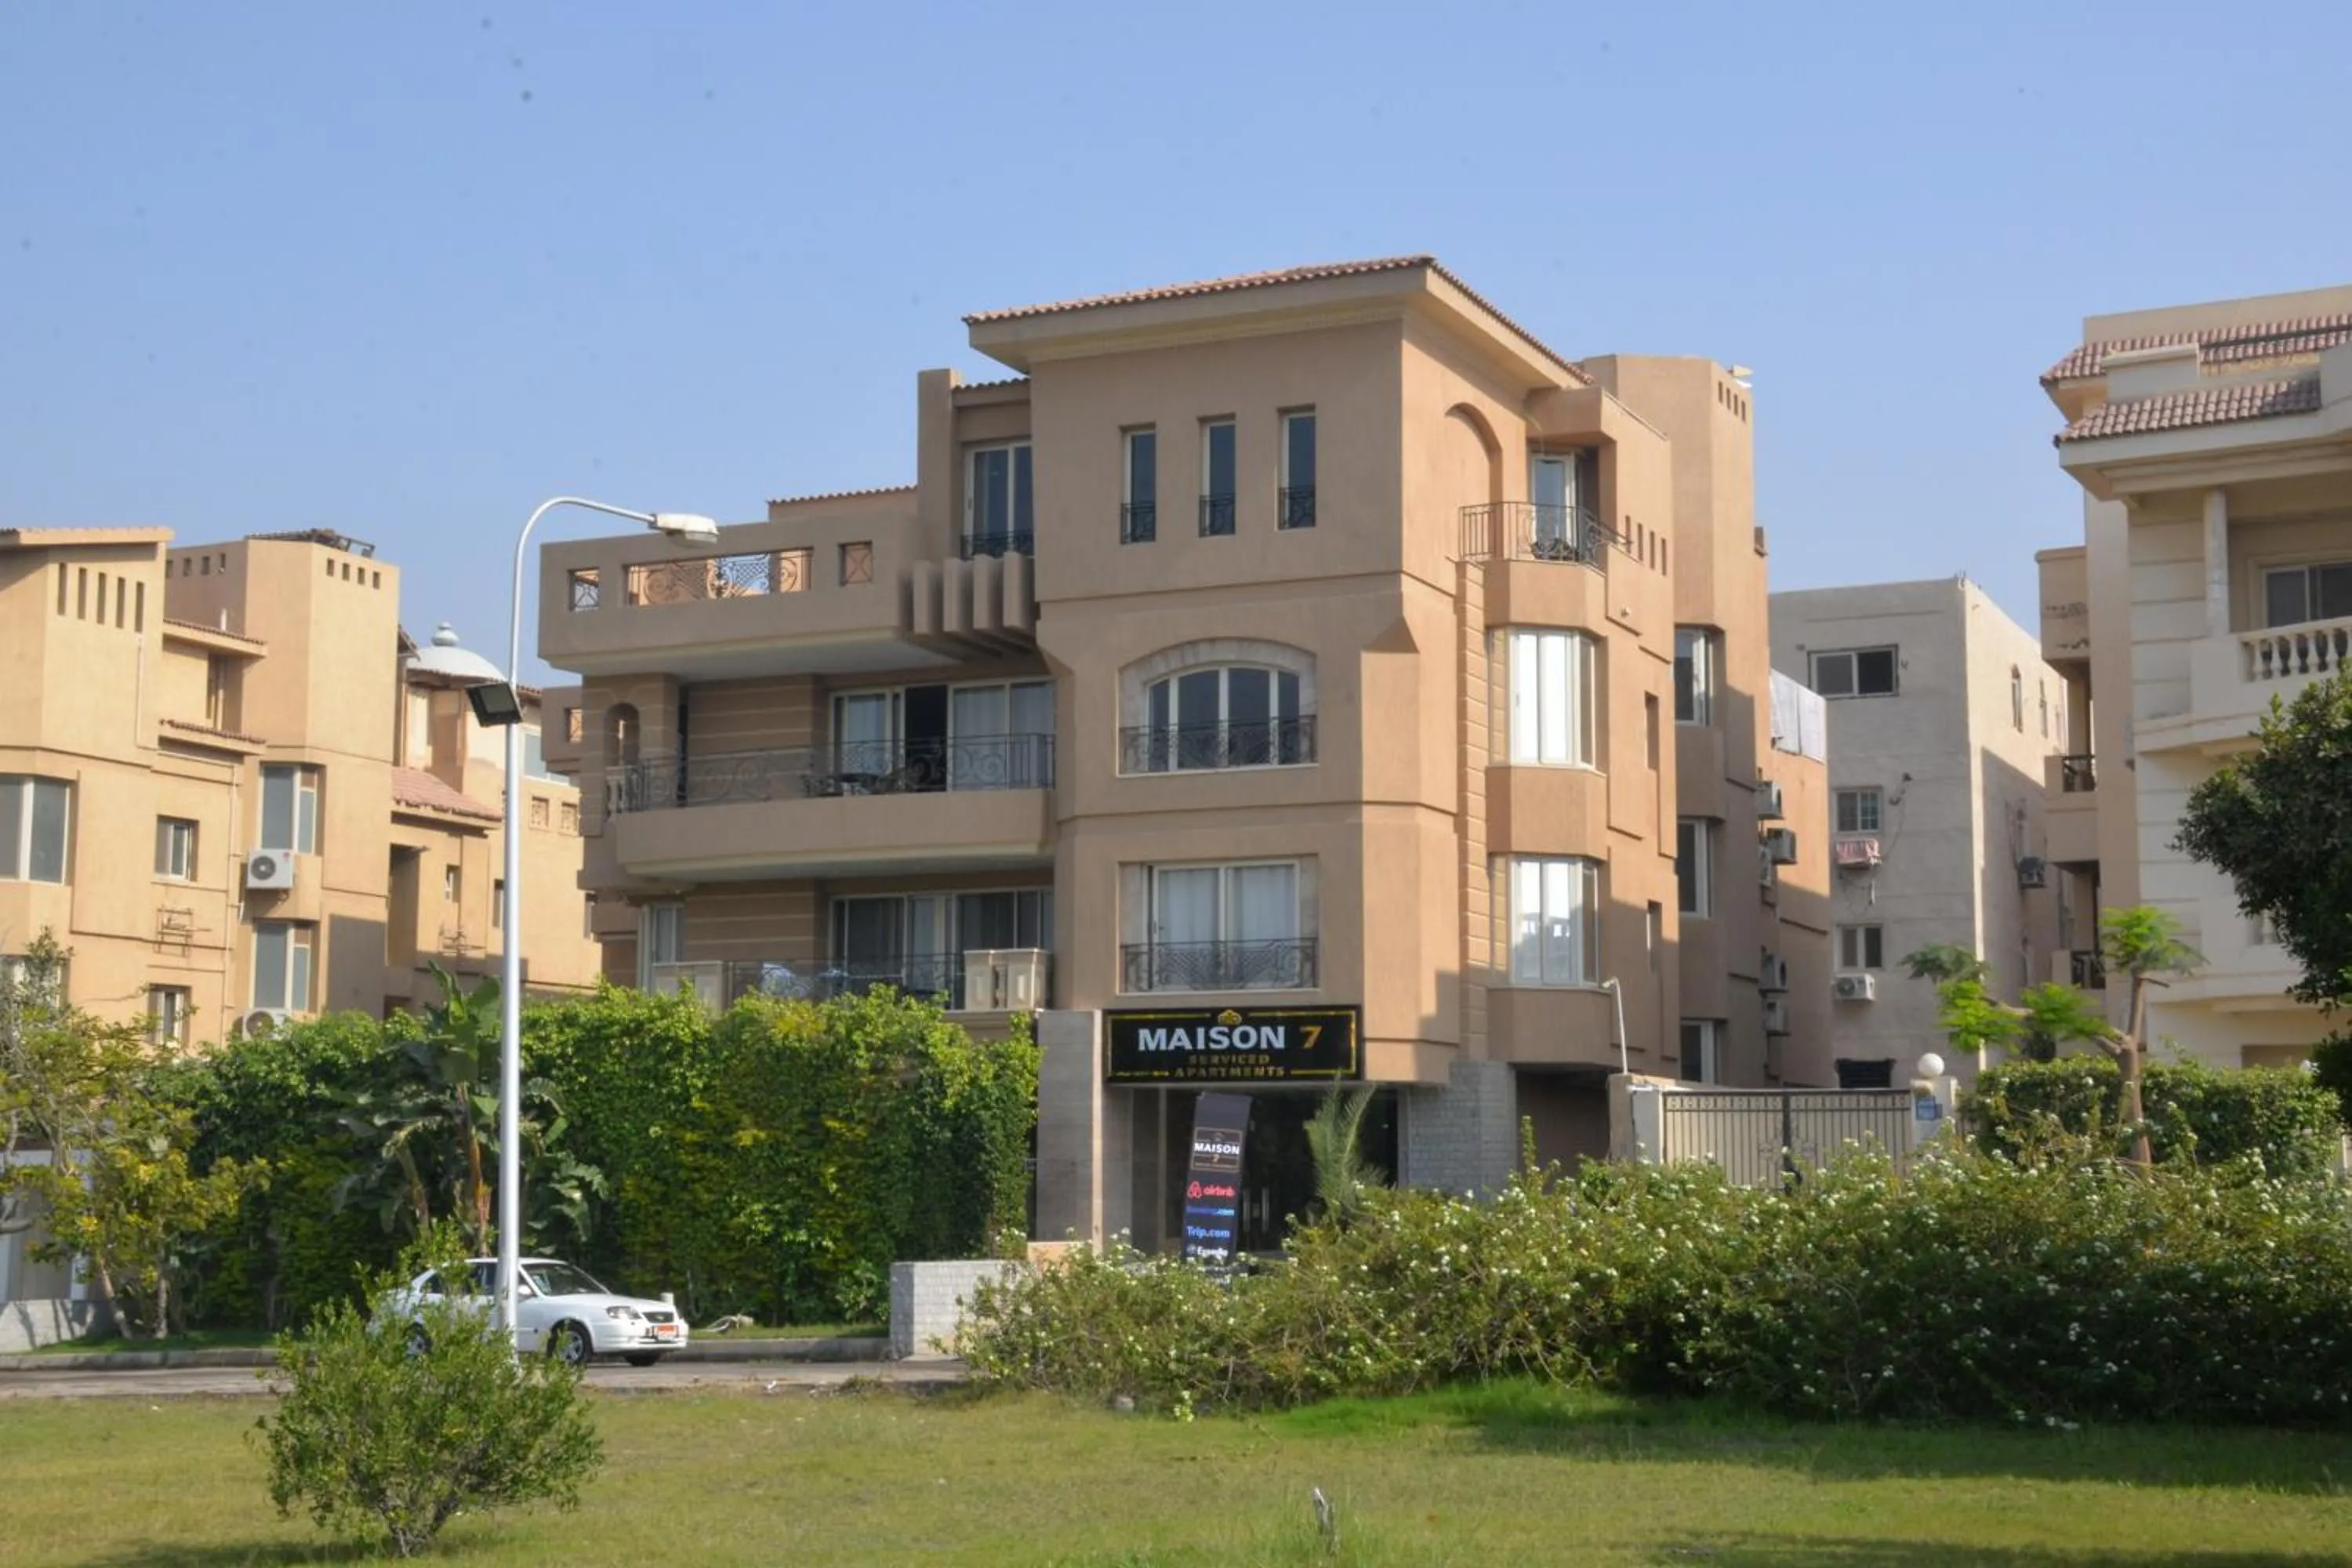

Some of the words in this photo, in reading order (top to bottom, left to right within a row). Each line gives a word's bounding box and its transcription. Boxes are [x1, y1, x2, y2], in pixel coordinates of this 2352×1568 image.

[1138, 1025, 1285, 1051] MAISON
[1299, 1025, 1323, 1049] 7
[1189, 1054, 1270, 1065] SERVICED
[1174, 1065, 1285, 1078] APARTMENTS
[1194, 1142, 1240, 1155] MAISON
[1203, 1185, 1235, 1198] airbnb
[1186, 1225, 1230, 1239] Trip.com
